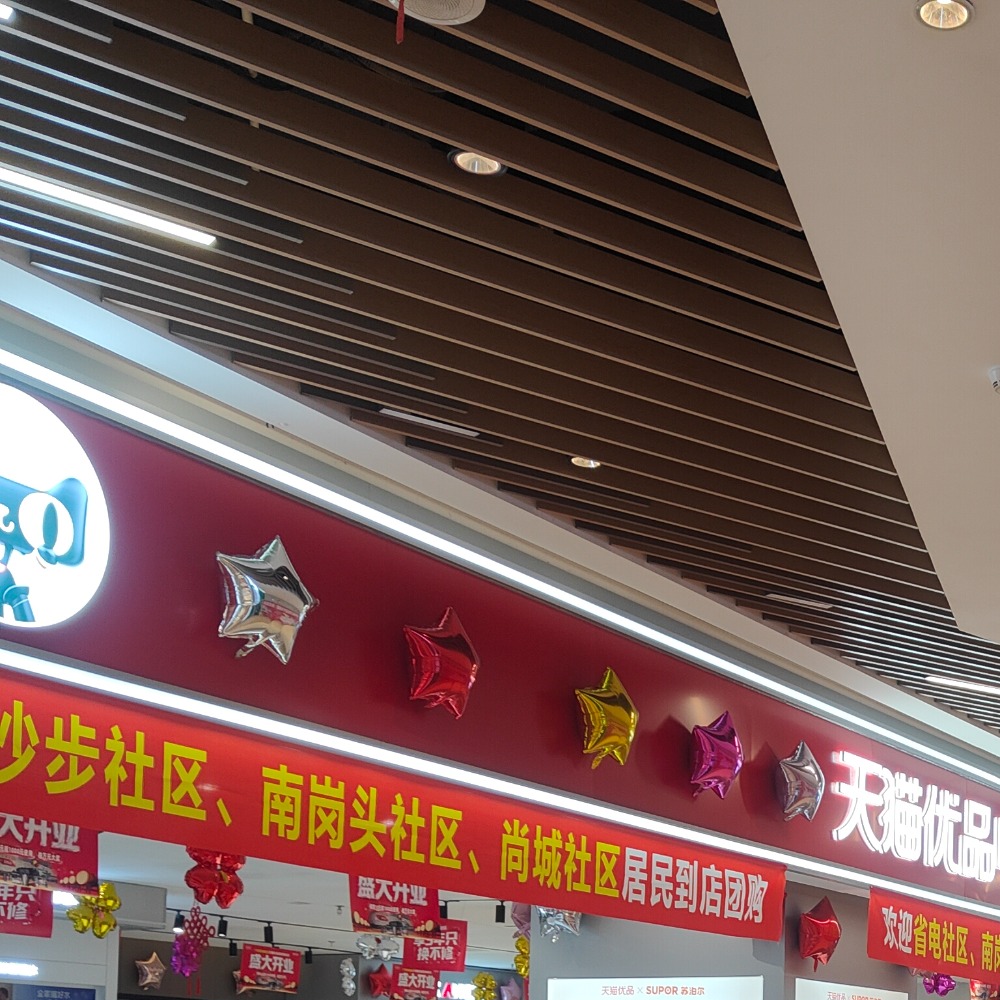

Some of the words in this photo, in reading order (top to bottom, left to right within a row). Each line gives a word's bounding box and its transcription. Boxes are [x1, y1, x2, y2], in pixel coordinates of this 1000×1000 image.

[248, 953, 294, 974] 盛大开业
[397, 973, 435, 989] 盛大开业
[601, 986, 634, 996] 天猫优品
[646, 986, 678, 995] SUPOR
[681, 987, 705, 996] 苏泊尔
